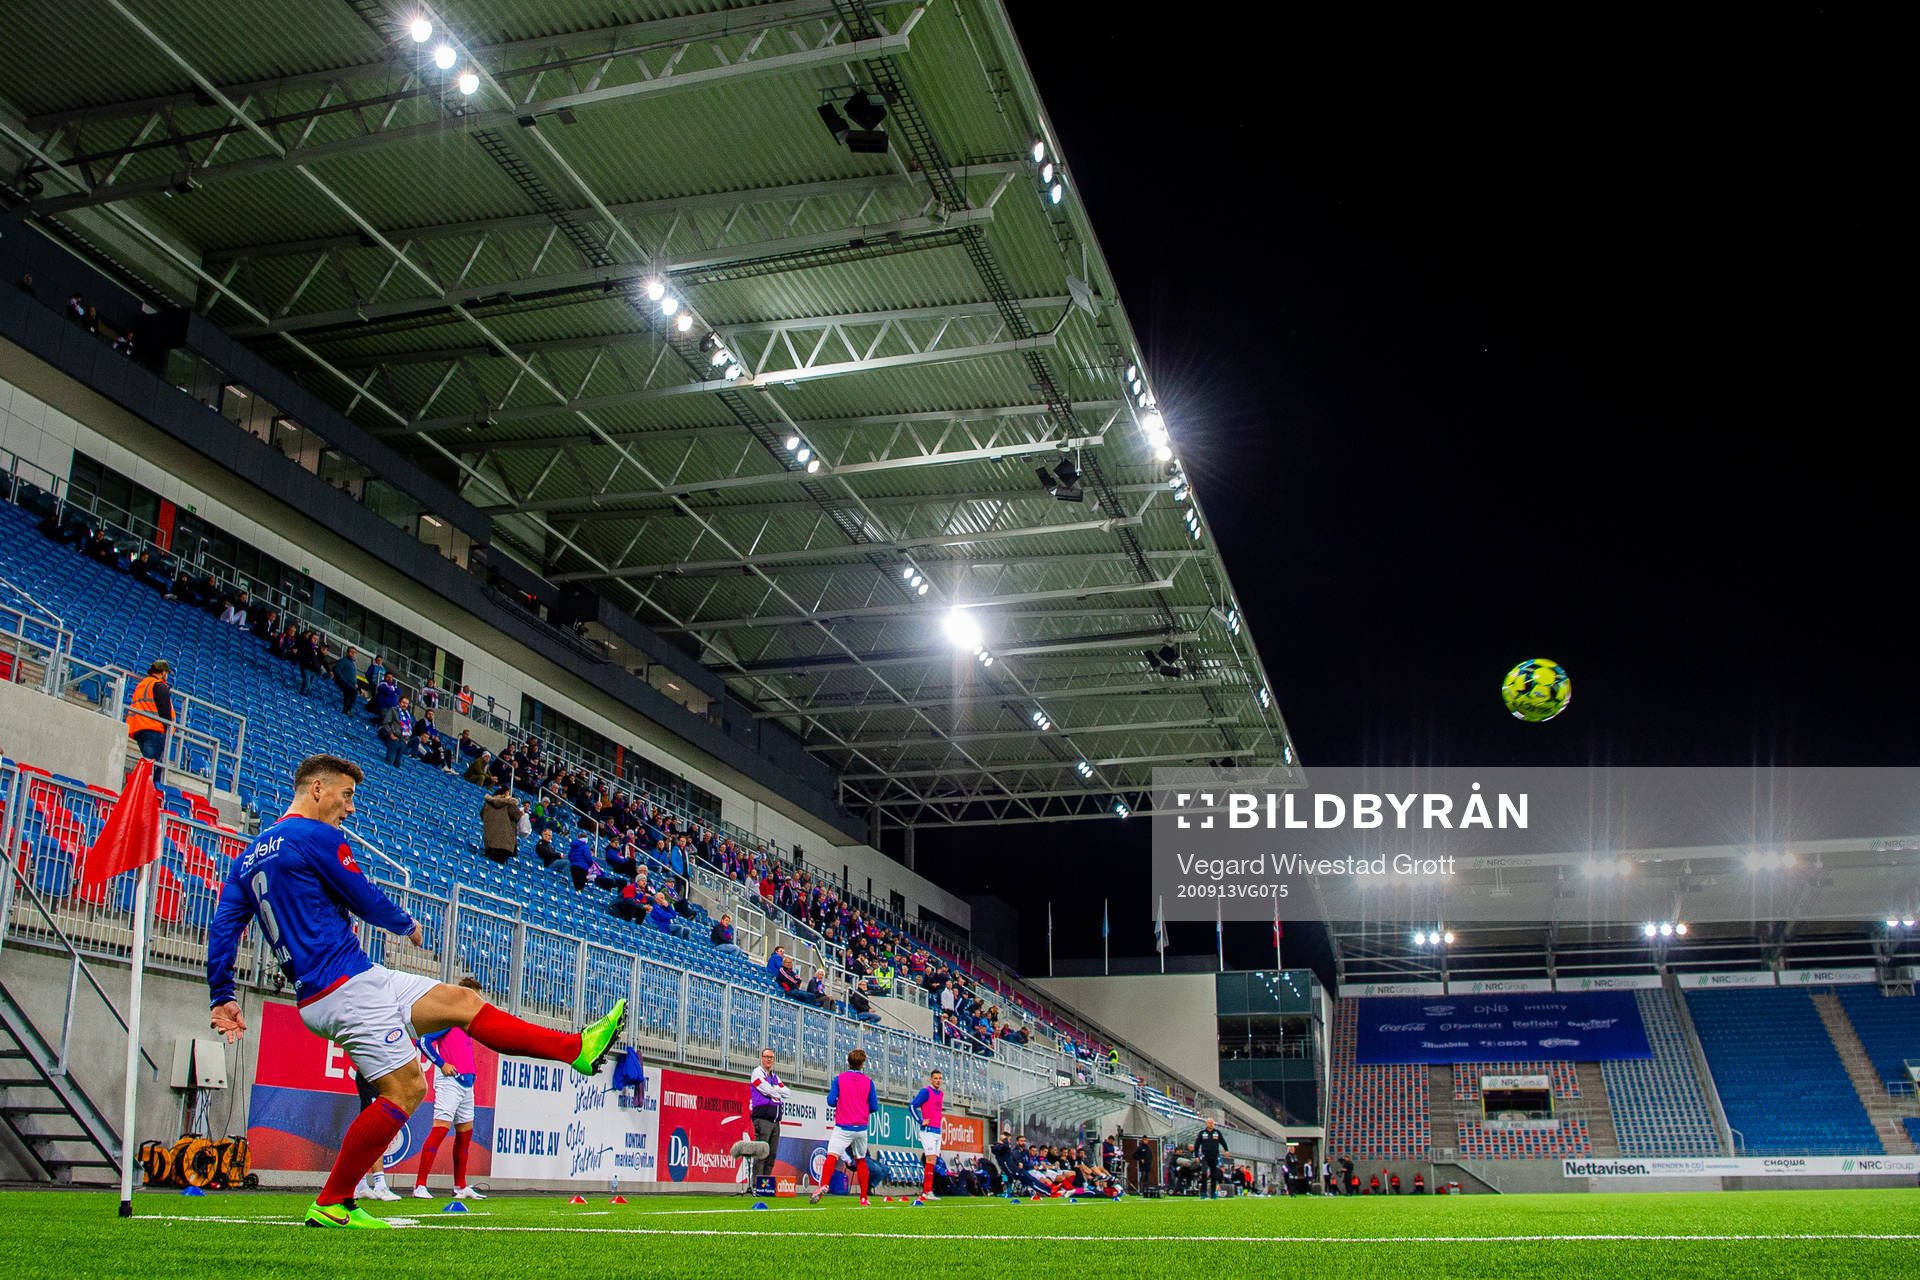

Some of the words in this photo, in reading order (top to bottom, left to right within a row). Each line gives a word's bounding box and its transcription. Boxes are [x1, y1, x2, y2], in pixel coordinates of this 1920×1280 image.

[1814, 972, 1833, 980] NRC
[1377, 986, 1395, 994] NRC
[1485, 982, 1503, 990] NRC
[1473, 1003, 1509, 1015] DNB
[501, 1060, 516, 1087] BLI
[519, 1063, 533, 1089] EN
[533, 1065, 549, 1091] DEL
[551, 1068, 564, 1093] AV
[869, 1104, 890, 1146] DNB
[496, 1127, 512, 1153] BLI
[514, 1129, 527, 1155] EN
[529, 1130, 544, 1156] DEL
[546, 1132, 560, 1157] AV
[669, 1135, 689, 1168] Da
[692, 1146, 736, 1174] Dagsavisen
[1859, 1160, 1883, 1170] NRC
[1883, 1161, 1915, 1172] Group
[1565, 1161, 1650, 1175] Nettavisen.
